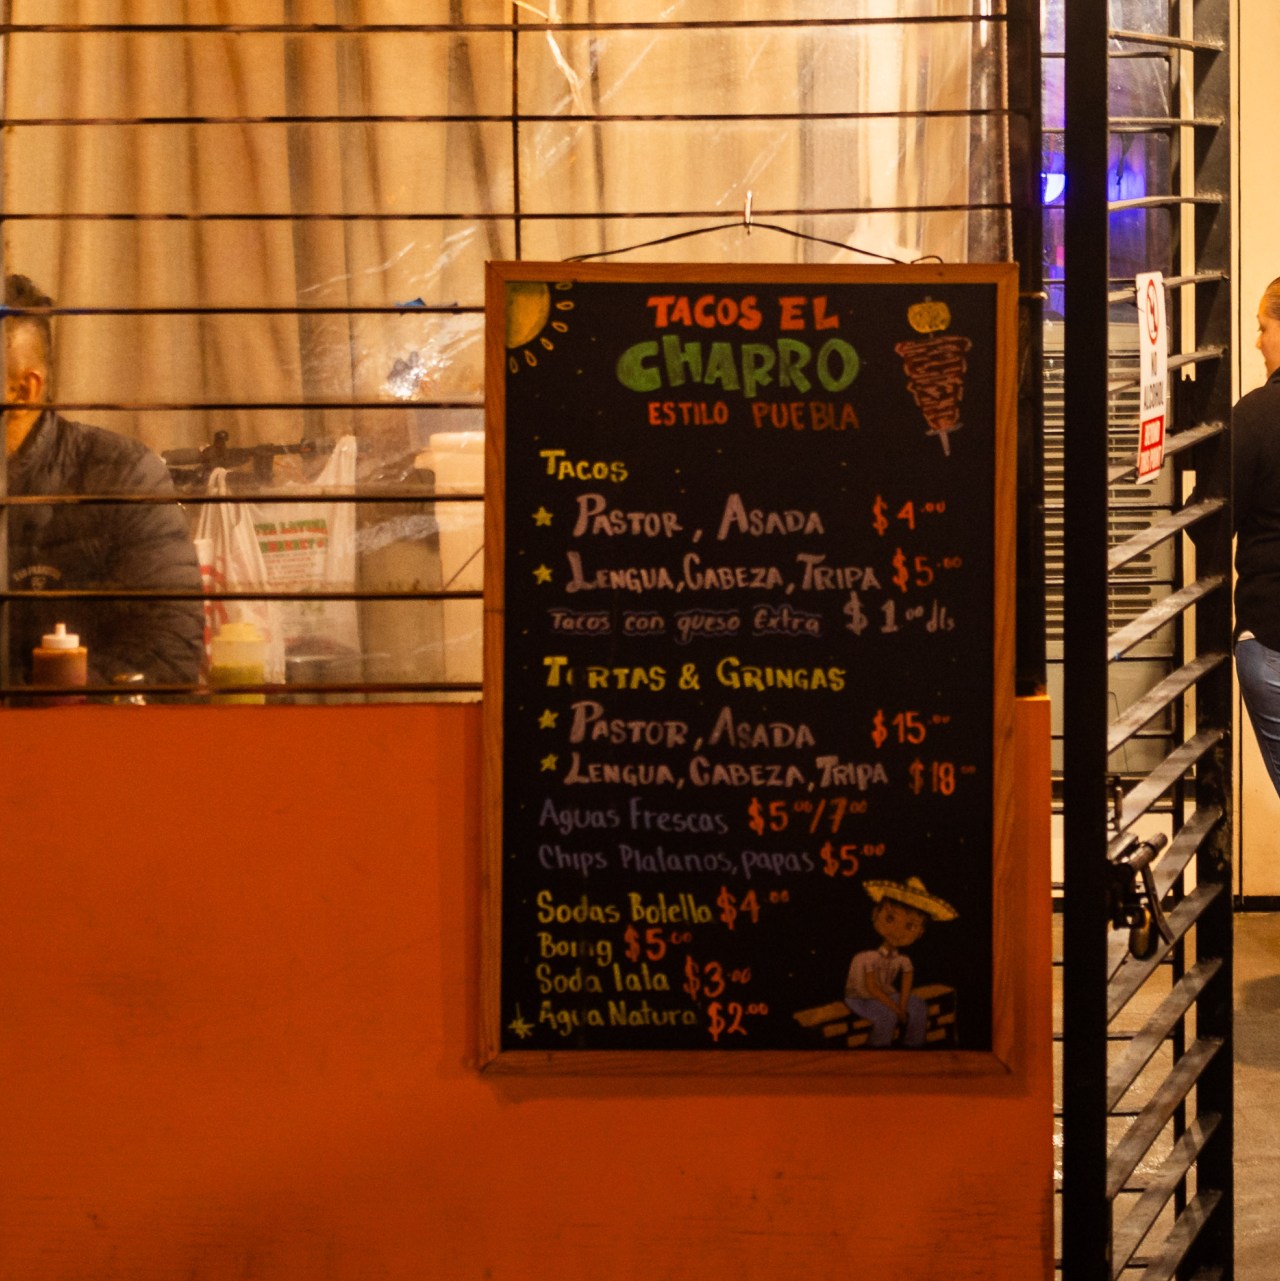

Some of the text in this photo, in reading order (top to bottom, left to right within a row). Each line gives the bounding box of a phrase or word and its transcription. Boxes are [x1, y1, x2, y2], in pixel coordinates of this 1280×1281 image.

[646, 294, 840, 331] TACOS EL
[615, 334, 860, 398] CHARRO
[646, 400, 861, 432] ESTILO PUEBLA
[539, 448, 629, 482] TACOS
[717, 492, 825, 541] ASADA
[549, 610, 611, 633] Tacos
[623, 611, 666, 634] con
[674, 611, 741, 643] queso
[678, 662, 701, 690] &
[715, 656, 847, 692] GRINGAS
[708, 705, 816, 749] ASADA
[816, 754, 889, 791] TRIPA
[538, 796, 620, 835] Aguas
[629, 796, 729, 834] Frescas
[538, 843, 608, 878] Chips
[535, 889, 620, 924] Sodas
[535, 962, 603, 994] Soda
